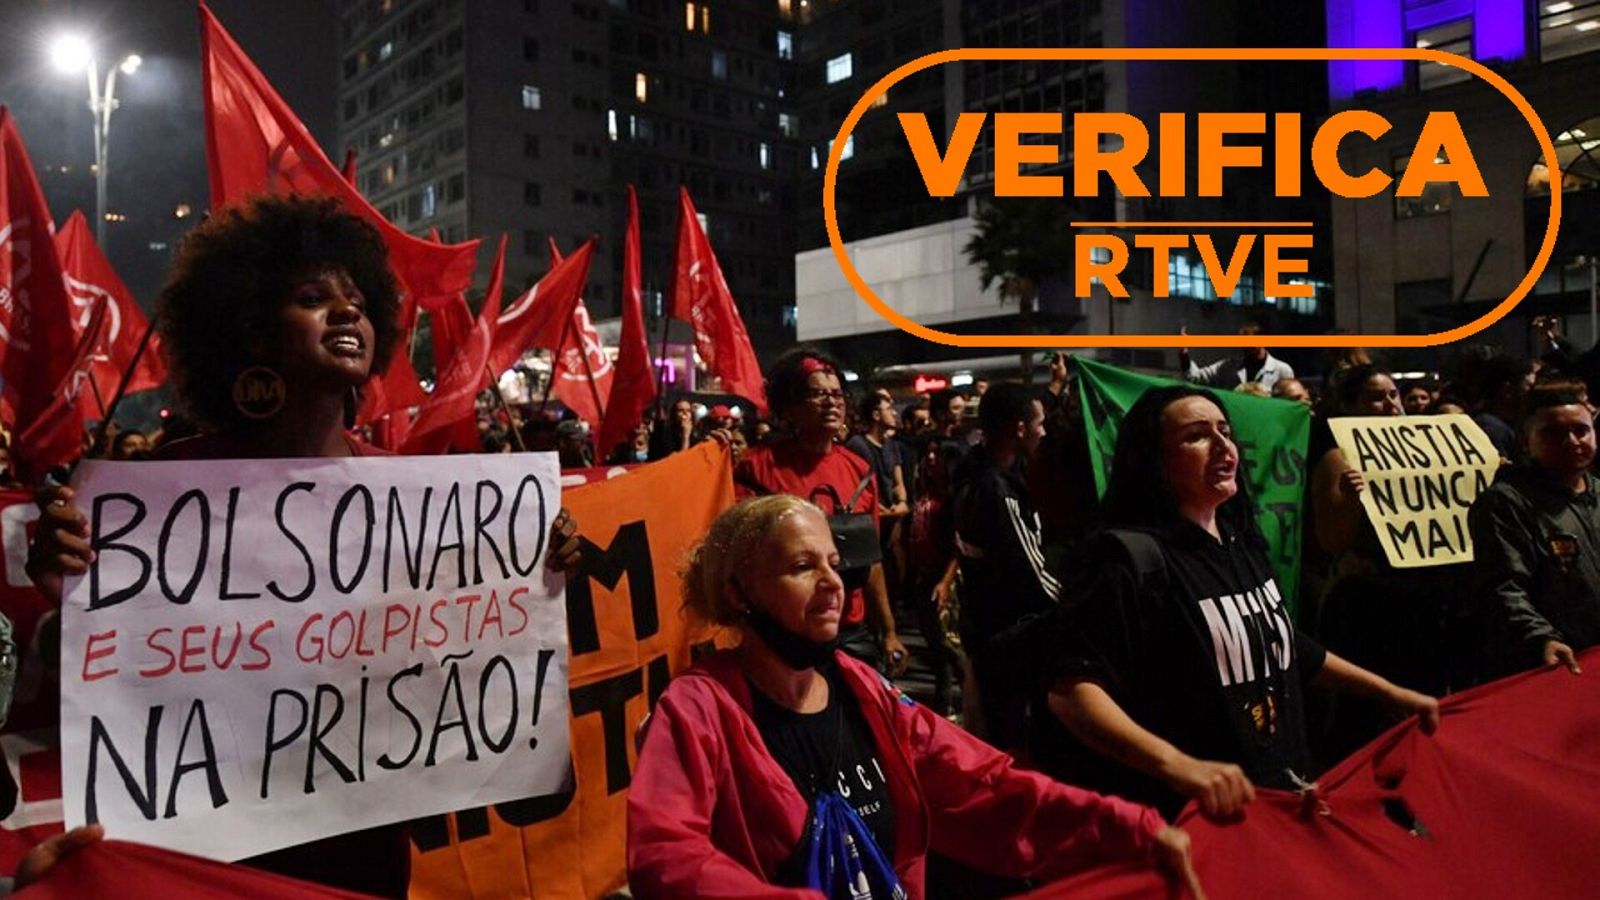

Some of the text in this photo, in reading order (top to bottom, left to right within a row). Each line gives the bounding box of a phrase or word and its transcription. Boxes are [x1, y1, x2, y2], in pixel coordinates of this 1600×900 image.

[1351, 422, 1487, 472] ANISTIA
[85, 474, 547, 611] BOLSONARO
[1386, 514, 1467, 561] MAI
[82, 630, 119, 682] E
[139, 619, 275, 678] SEUS
[296, 587, 530, 667] GOLPISTAS
[85, 698, 229, 825] NA
[837, 757, 886, 798] CCI
